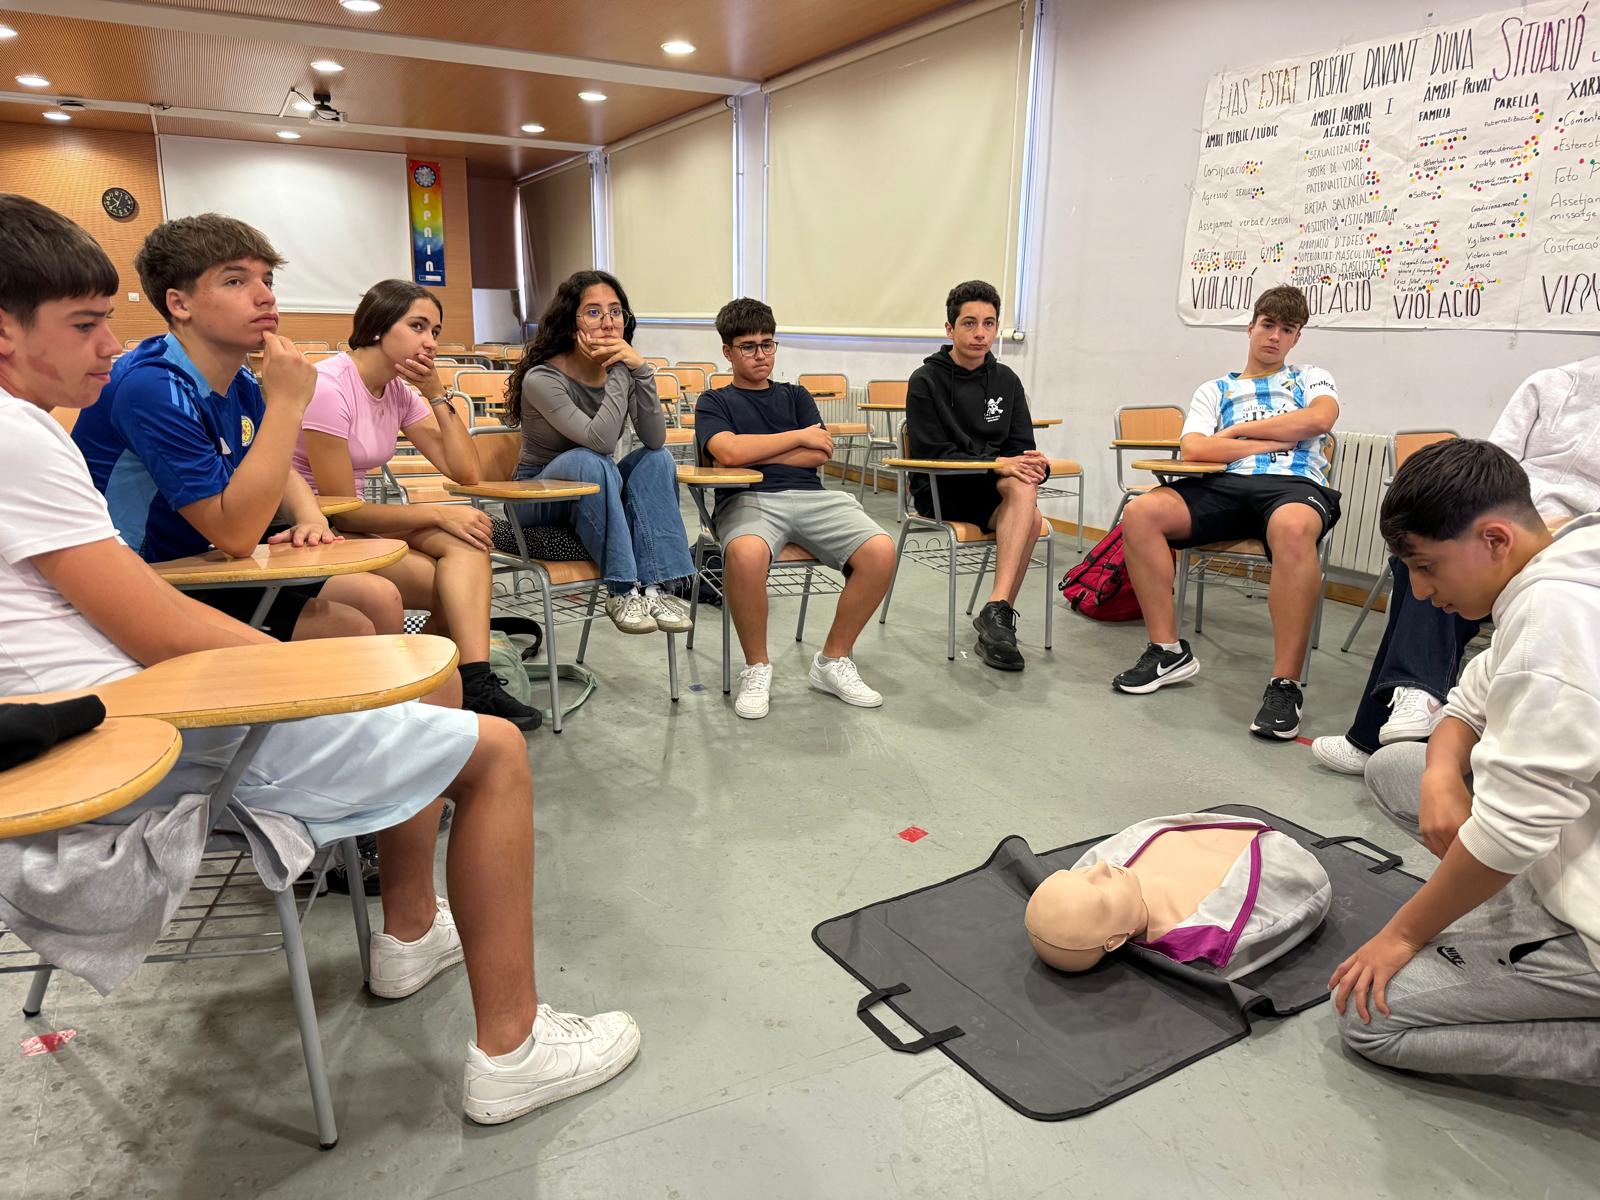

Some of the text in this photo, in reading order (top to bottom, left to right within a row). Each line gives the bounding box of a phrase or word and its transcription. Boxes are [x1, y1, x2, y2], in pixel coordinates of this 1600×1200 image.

[1258, 66, 1300, 109] ESTAT
[1307, 52, 1355, 101] PRESENT
[1363, 37, 1422, 90] DAVANT
[1493, 1, 1589, 81] SITUACIÓ
[1494, 92, 1539, 110] PARELLA
[1340, 101, 1372, 122] LABORAL
[1330, 162, 1338, 173] DE
[1342, 157, 1363, 172] VIDRE
[1555, 167, 1578, 184] Foto
[1332, 192, 1369, 211] SALARIAL
[1550, 211, 1597, 221] missatge
[1261, 246, 1276, 260] GYM
[1543, 236, 1599, 254] Cosificació
[1192, 266, 1258, 310] VIOLACIÓ
[1444, 946, 1466, 966] NIKE
